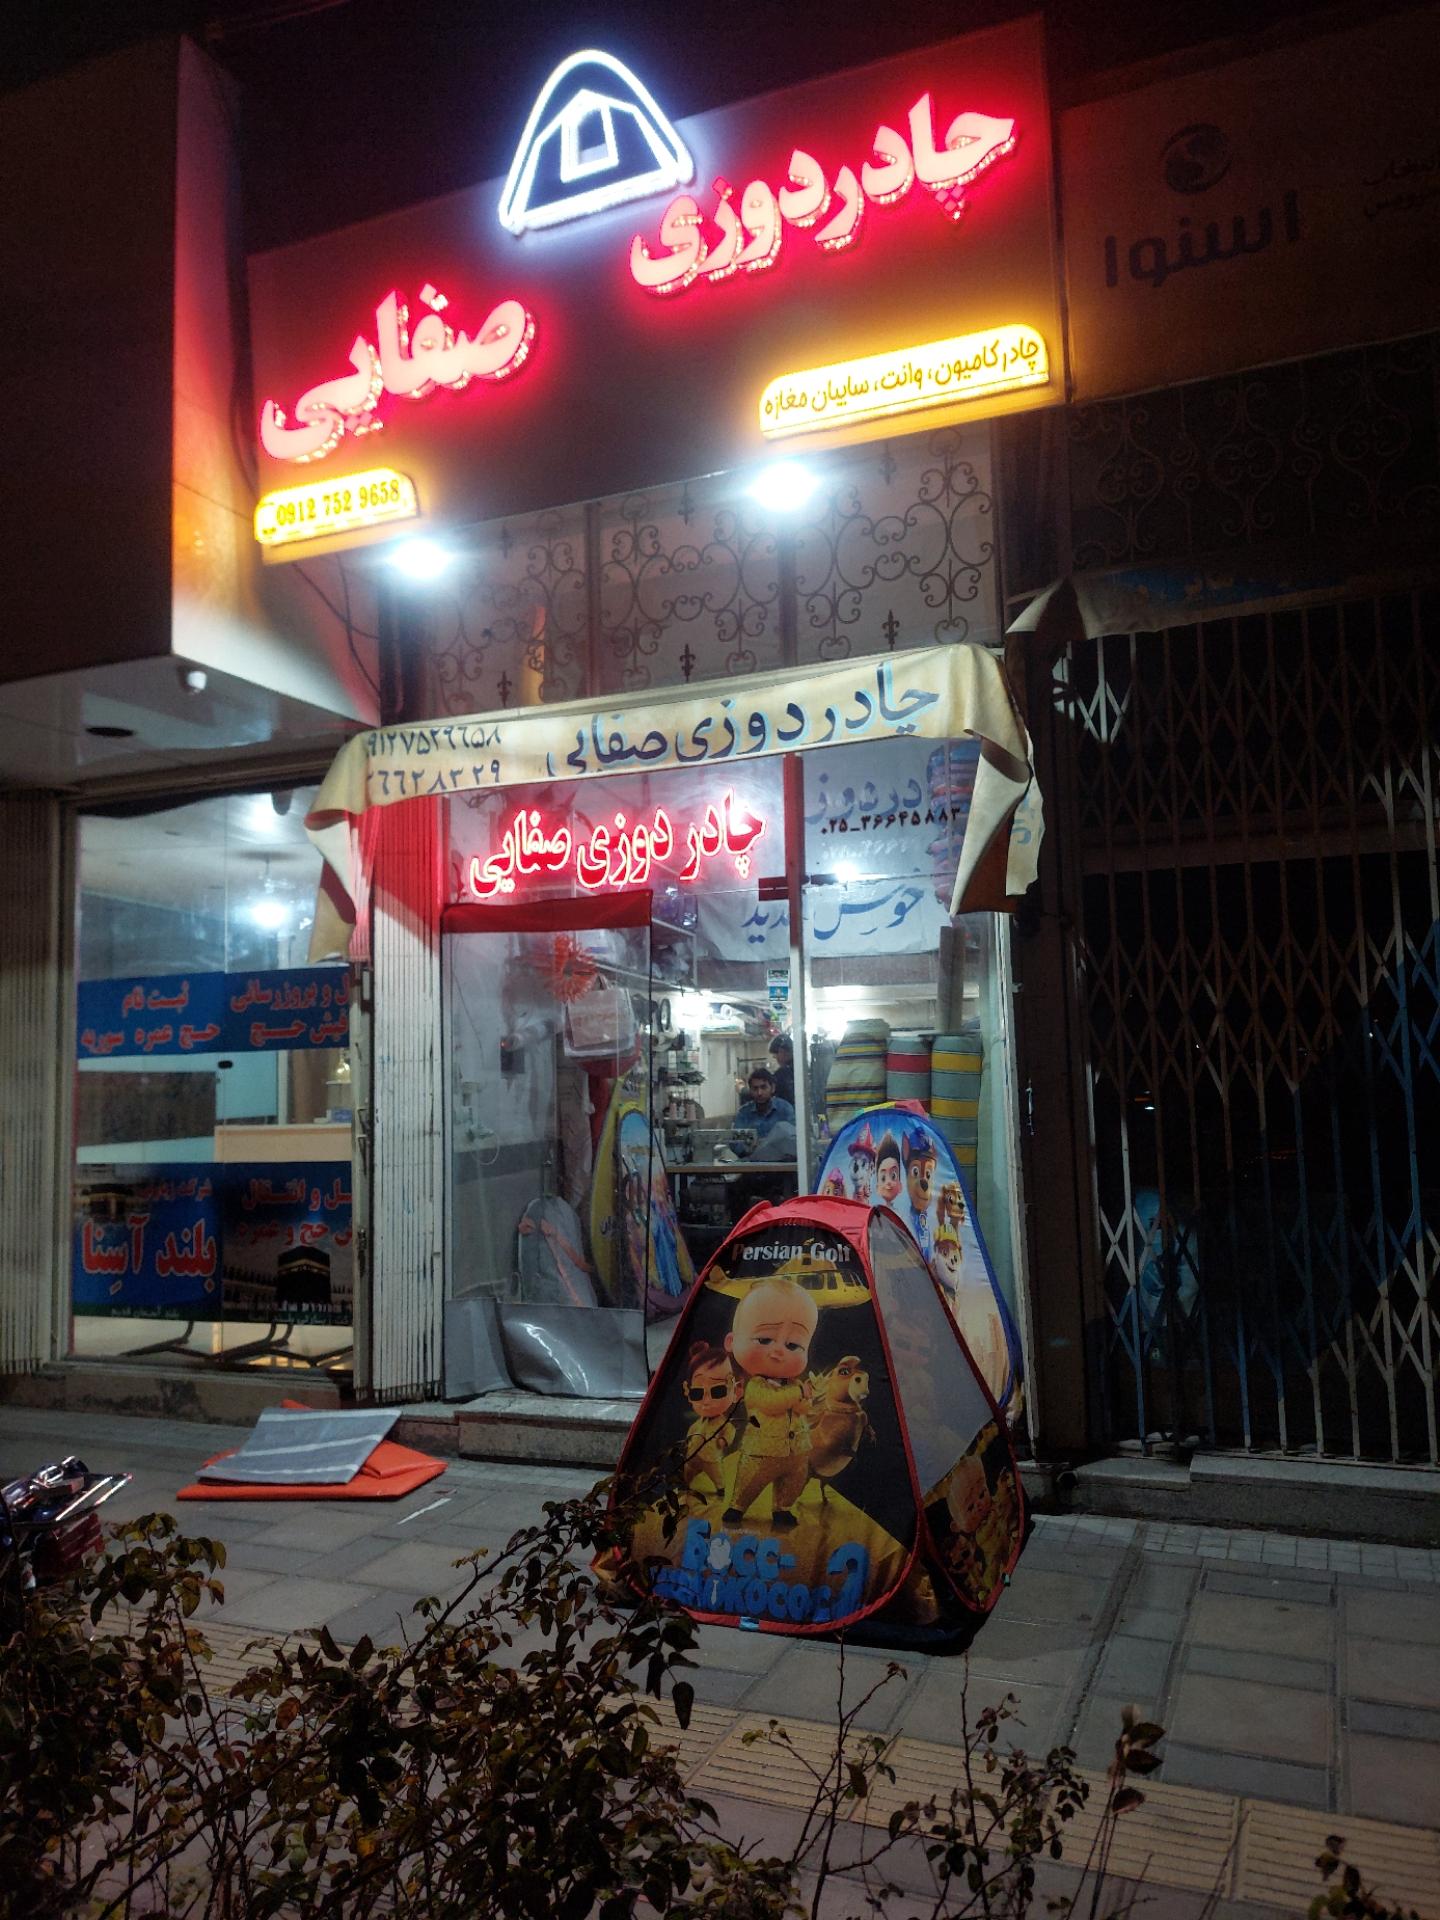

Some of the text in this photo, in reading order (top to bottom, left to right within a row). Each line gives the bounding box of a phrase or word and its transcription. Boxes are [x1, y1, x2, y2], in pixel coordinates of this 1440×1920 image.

[1001, 336, 1040, 372] چادر
[764, 387, 808, 421] مغازه
[276, 478, 401, 527] 0912 752 9658
[470, 809, 571, 898] صفایی
[122, 980, 190, 1018] ثبت نام
[134, 1024, 173, 1053] عمره
[179, 1022, 221, 1050] حج
[250, 1020, 306, 1048] حج
[300, 1221, 329, 1246] حج
[155, 1217, 217, 1294] بلند
[731, 1241, 803, 1261] Persian
